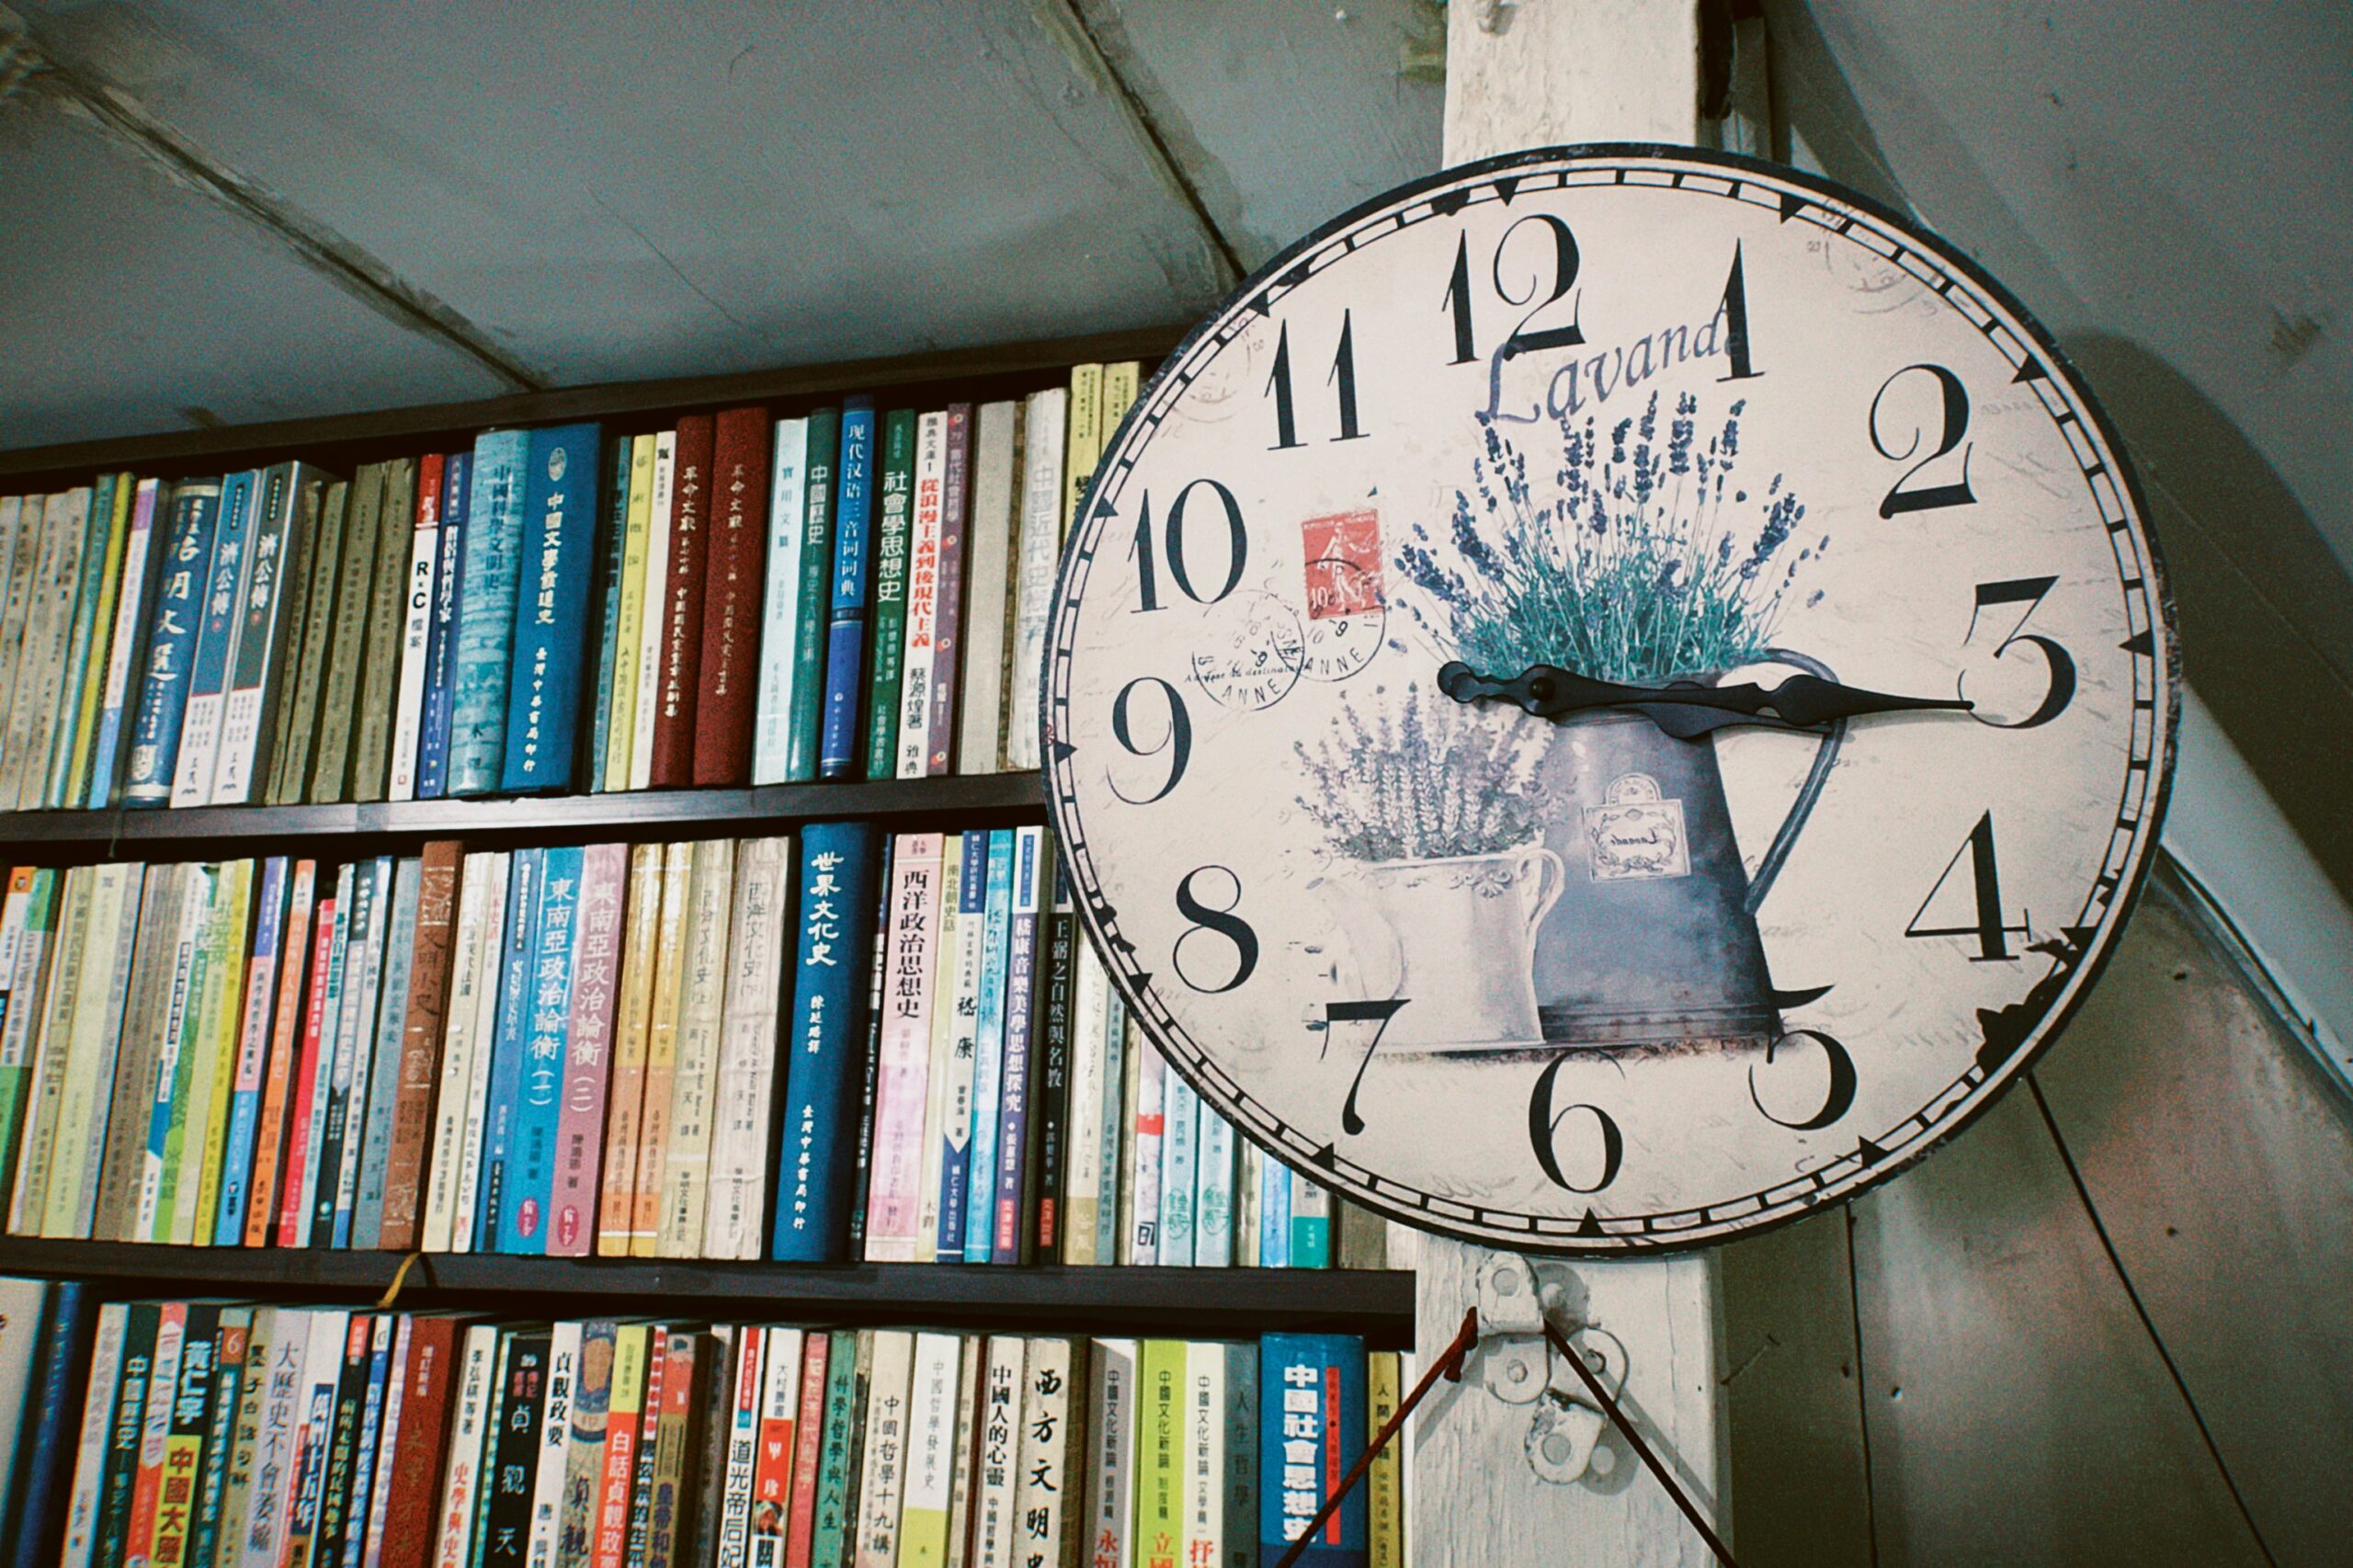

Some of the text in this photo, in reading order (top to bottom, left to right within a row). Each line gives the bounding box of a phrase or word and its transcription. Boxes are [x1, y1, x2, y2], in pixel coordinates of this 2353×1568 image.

[1442, 213, 1586, 366] 12
[1716, 237, 1766, 382] 1
[1265, 308, 1371, 451] 11
[1870, 364, 1978, 520] 2
[839, 424, 867, 597] 现代汉语三音词词典
[876, 470, 910, 605] 社會學思想史
[910, 477, 939, 648] 從浪漫主義到後現代主義
[1126, 478, 1247, 615] 10
[1958, 574, 2077, 730] 3
[1107, 676, 1192, 805] 9
[805, 851, 845, 966] 世界文化史
[895, 869, 932, 1019] 西洋政治思想史
[944, 864, 961, 933] 南北朝史話
[1172, 865, 1259, 994] 8
[1904, 809, 2030, 962] 4
[953, 995, 978, 1061] 嵇康
[1046, 919, 1070, 1090] 王弼之自然與名教
[1319, 998, 1411, 1136] 7
[1748, 984, 1859, 1131] 5
[1528, 1051, 1626, 1194] 6
[116, 1355, 149, 1450] 中國歷史
[175, 1340, 212, 1426] 黃仁宇
[225, 1334, 241, 1355] 6
[546, 1351, 571, 1449] 貞觀政要
[821, 1375, 850, 1532] 科學哲學與人生
[873, 1394, 902, 1556] 中國哲學十九講
[985, 1365, 1013, 1488] 中國人的心靈
[1104, 1369, 1120, 1470] 中國文化新論
[1156, 1369, 1172, 1470] 中國文化新論
[1197, 1375, 1211, 1477] 中國文化新論
[1283, 1363, 1319, 1544] 中國社會思想史
[442, 1464, 470, 1568] 史學與史
[720, 1439, 753, 1568] 道光帝后妃
